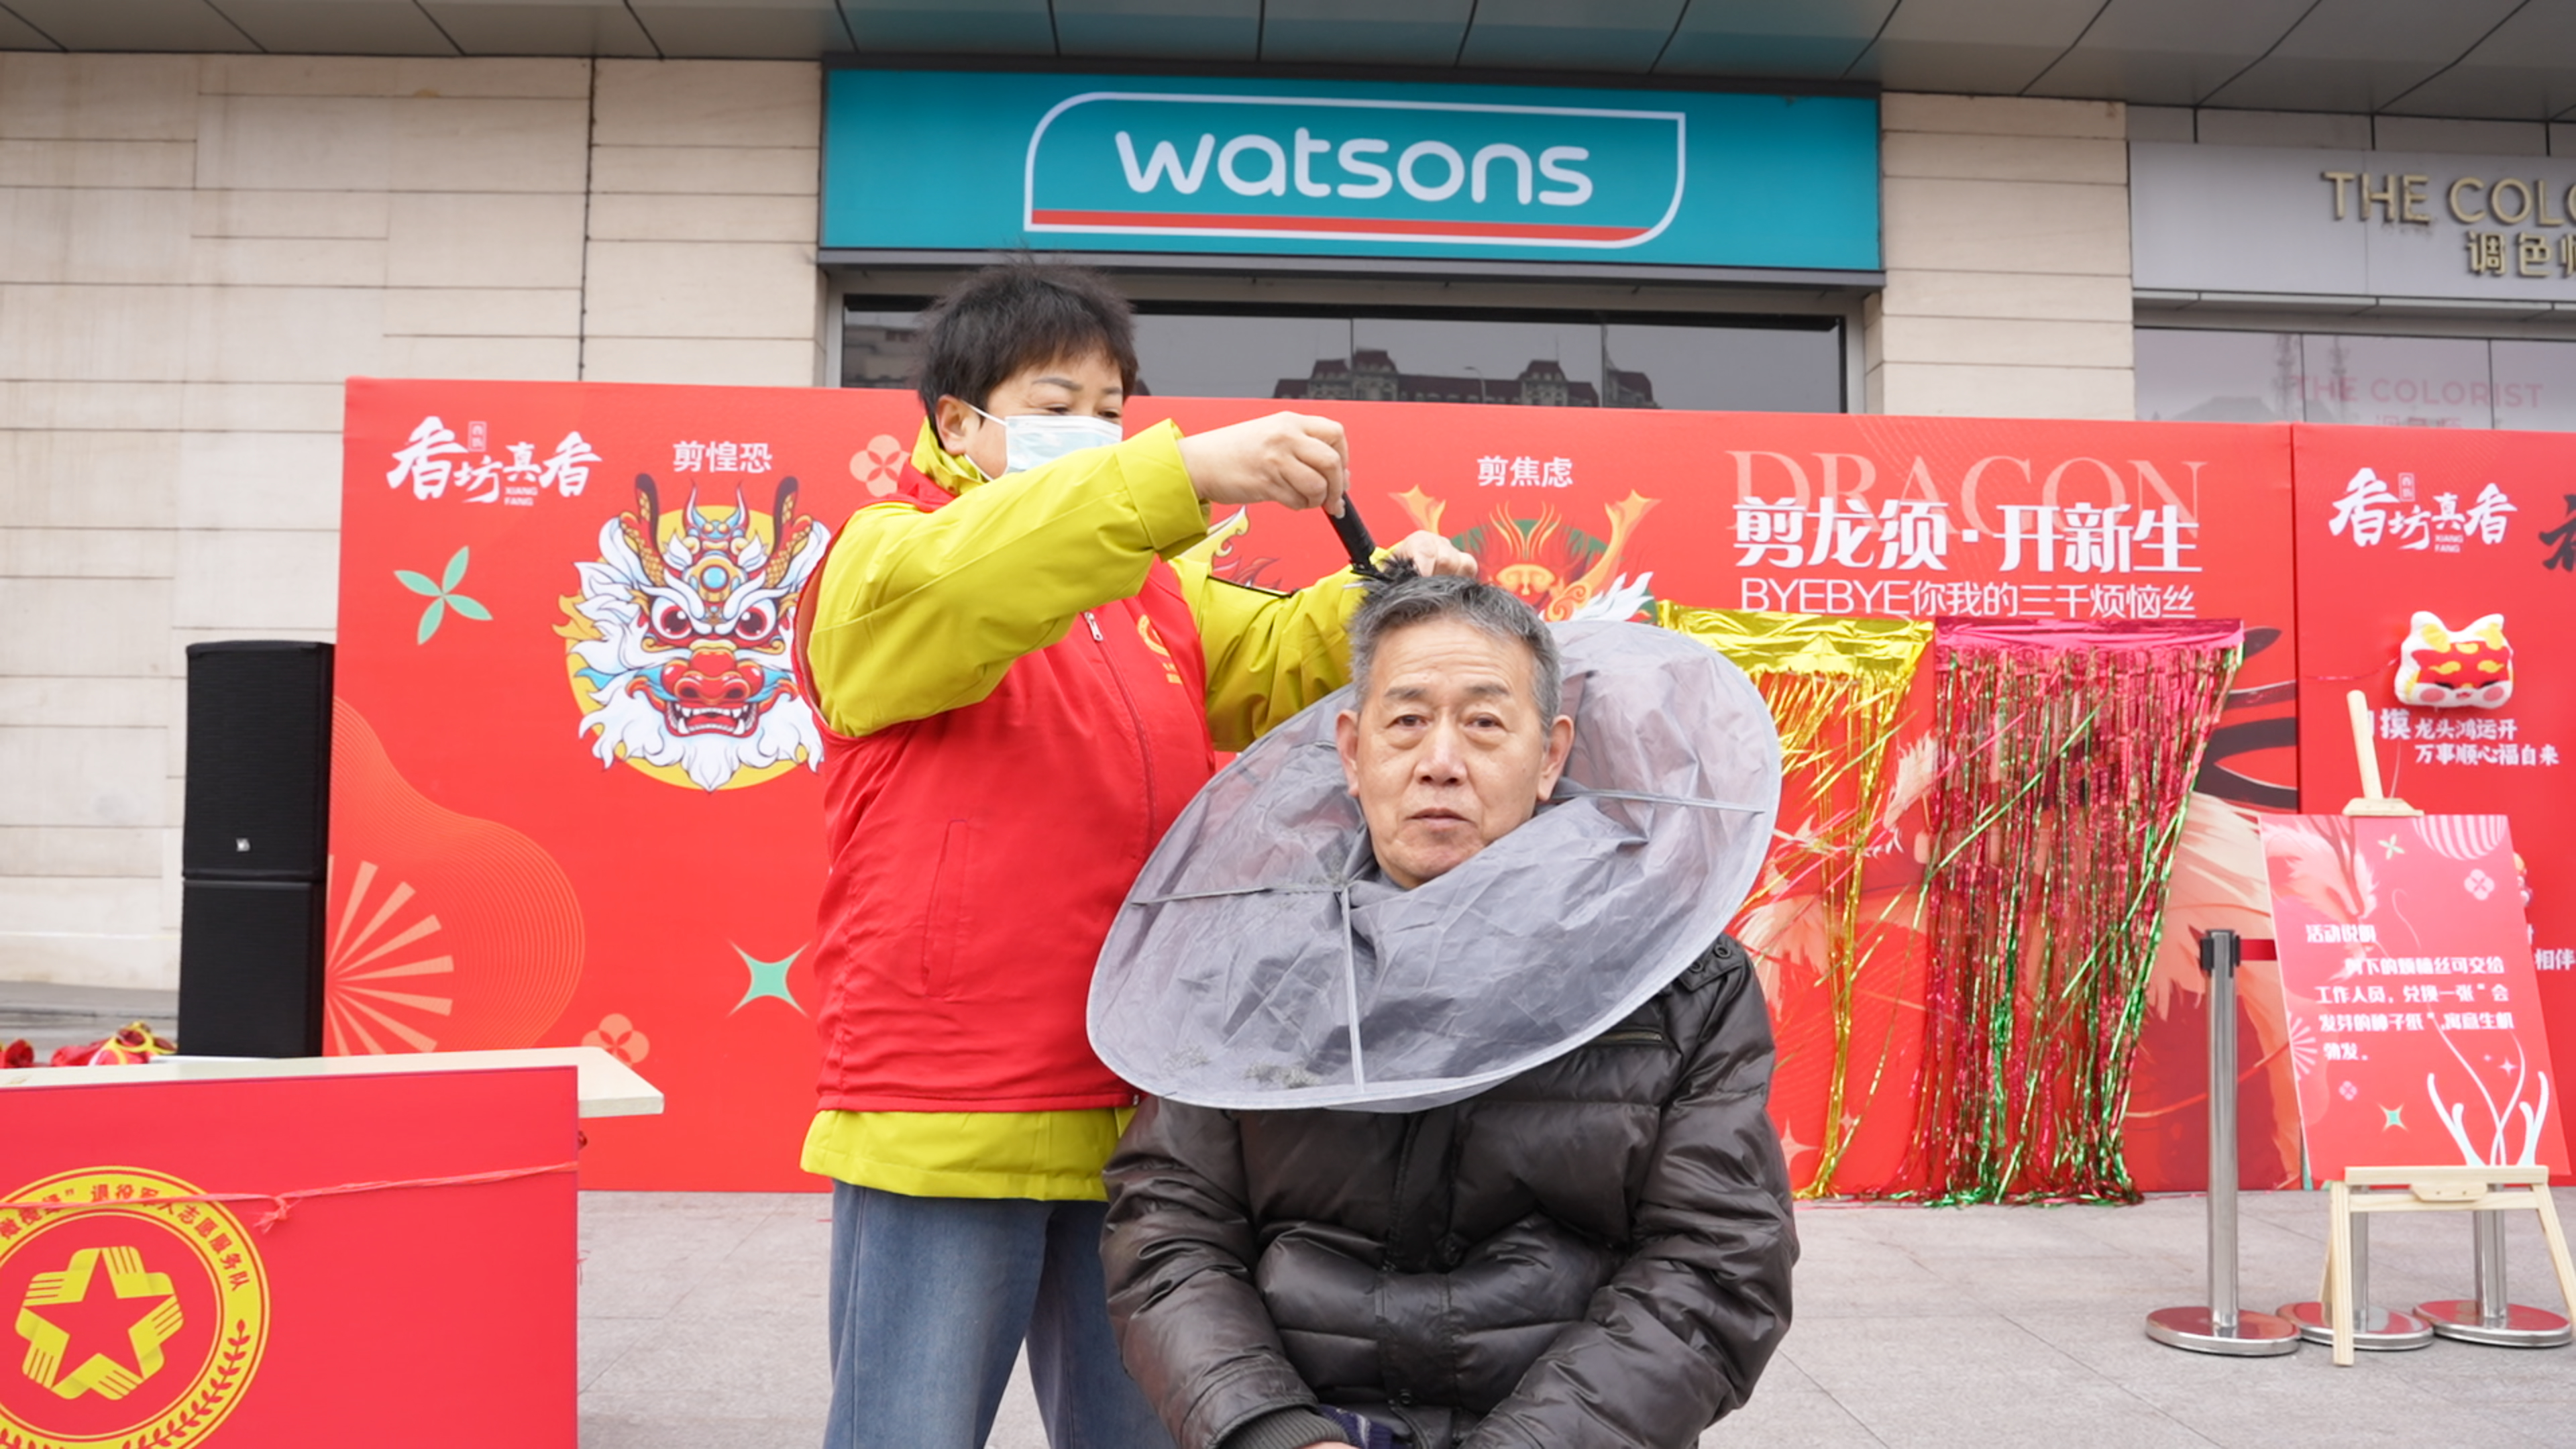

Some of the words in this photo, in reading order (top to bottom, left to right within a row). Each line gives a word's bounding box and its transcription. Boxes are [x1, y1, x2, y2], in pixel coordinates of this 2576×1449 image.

[1115, 127, 1593, 207] watsons
[2322, 172, 2431, 224] THE
[2449, 177, 2576, 227] COL
[2290, 375, 2359, 402] THE
[2370, 378, 2544, 409] COLORIST
[673, 440, 773, 474] 剪惶恐
[1477, 455, 1574, 488] 剪焦虑
[504, 497, 534, 506] FANG
[505, 487, 538, 496] XIANG
[1725, 449, 2208, 539] DRAGON
[2367, 708, 2412, 740] 摸
[2415, 718, 2518, 741] 龙头鸿运开
[2415, 743, 2560, 765] 万事顺心福自来
